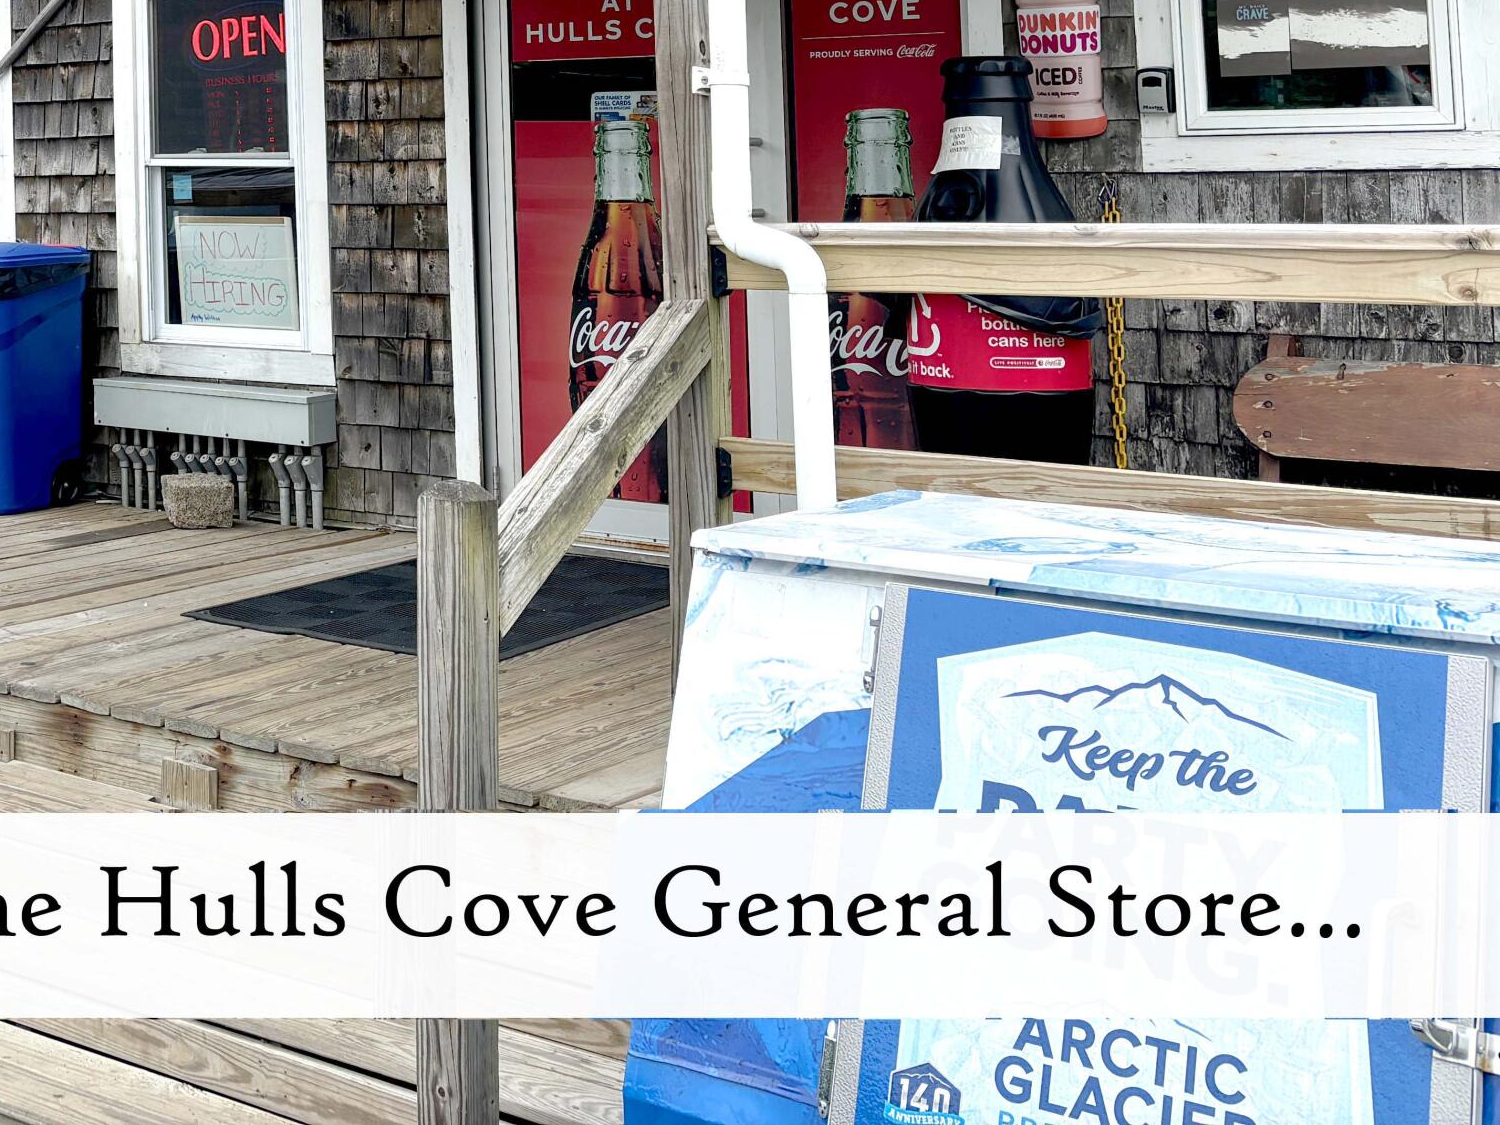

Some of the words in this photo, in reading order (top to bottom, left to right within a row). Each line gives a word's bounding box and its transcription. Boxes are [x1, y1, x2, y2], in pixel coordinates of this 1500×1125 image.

[1018, 10, 1099, 33] DUNKIN'
[1236, 7, 1269, 21] CRAVE
[191, 12, 287, 62] OPEN
[525, 19, 622, 44] HULLS
[1020, 31, 1098, 54] DONUTS
[809, 49, 851, 59] PROUDLY
[853, 48, 893, 58] SERVING
[896, 44, 937, 59] Coca-Cola
[1035, 67, 1077, 86] ICED
[199, 230, 260, 261] NOW
[189, 266, 285, 307] HIRING
[568, 306, 641, 368] Coca-
[987, 336, 1029, 348] cans
[1033, 332, 1065, 348] here
[912, 360, 918, 375] it
[920, 361, 954, 379] back.
[1038, 725, 1165, 792] Keep
[1169, 748, 1258, 796] the
[1013, 1019, 1249, 1105] ARCTIC
[900, 1077, 951, 1115] 140
[887, 1107, 963, 1125] ANNIVERSARY
